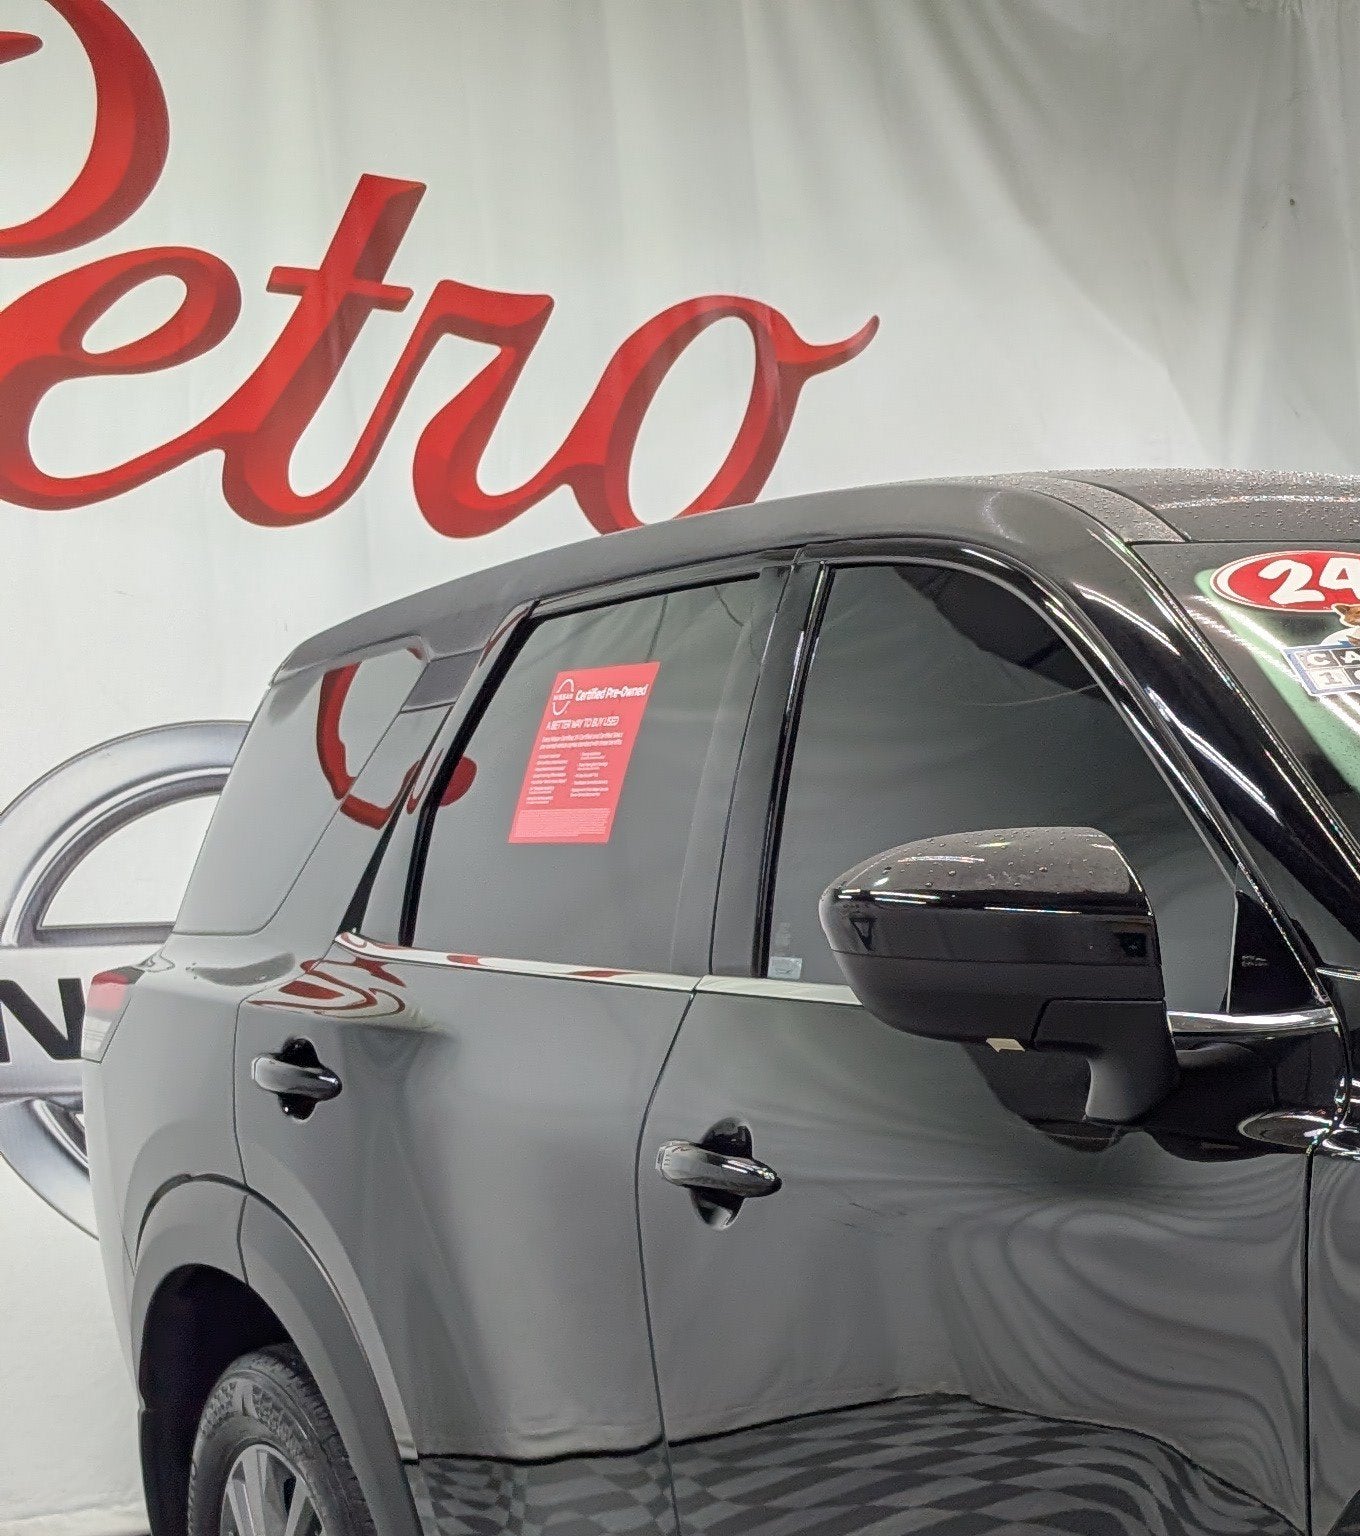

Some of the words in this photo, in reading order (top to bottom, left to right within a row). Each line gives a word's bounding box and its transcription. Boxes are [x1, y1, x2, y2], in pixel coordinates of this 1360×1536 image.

[1317, 670, 1343, 687] 1
[575, 687, 608, 701] Certified
[606, 683, 650, 699] Pre-Owned
